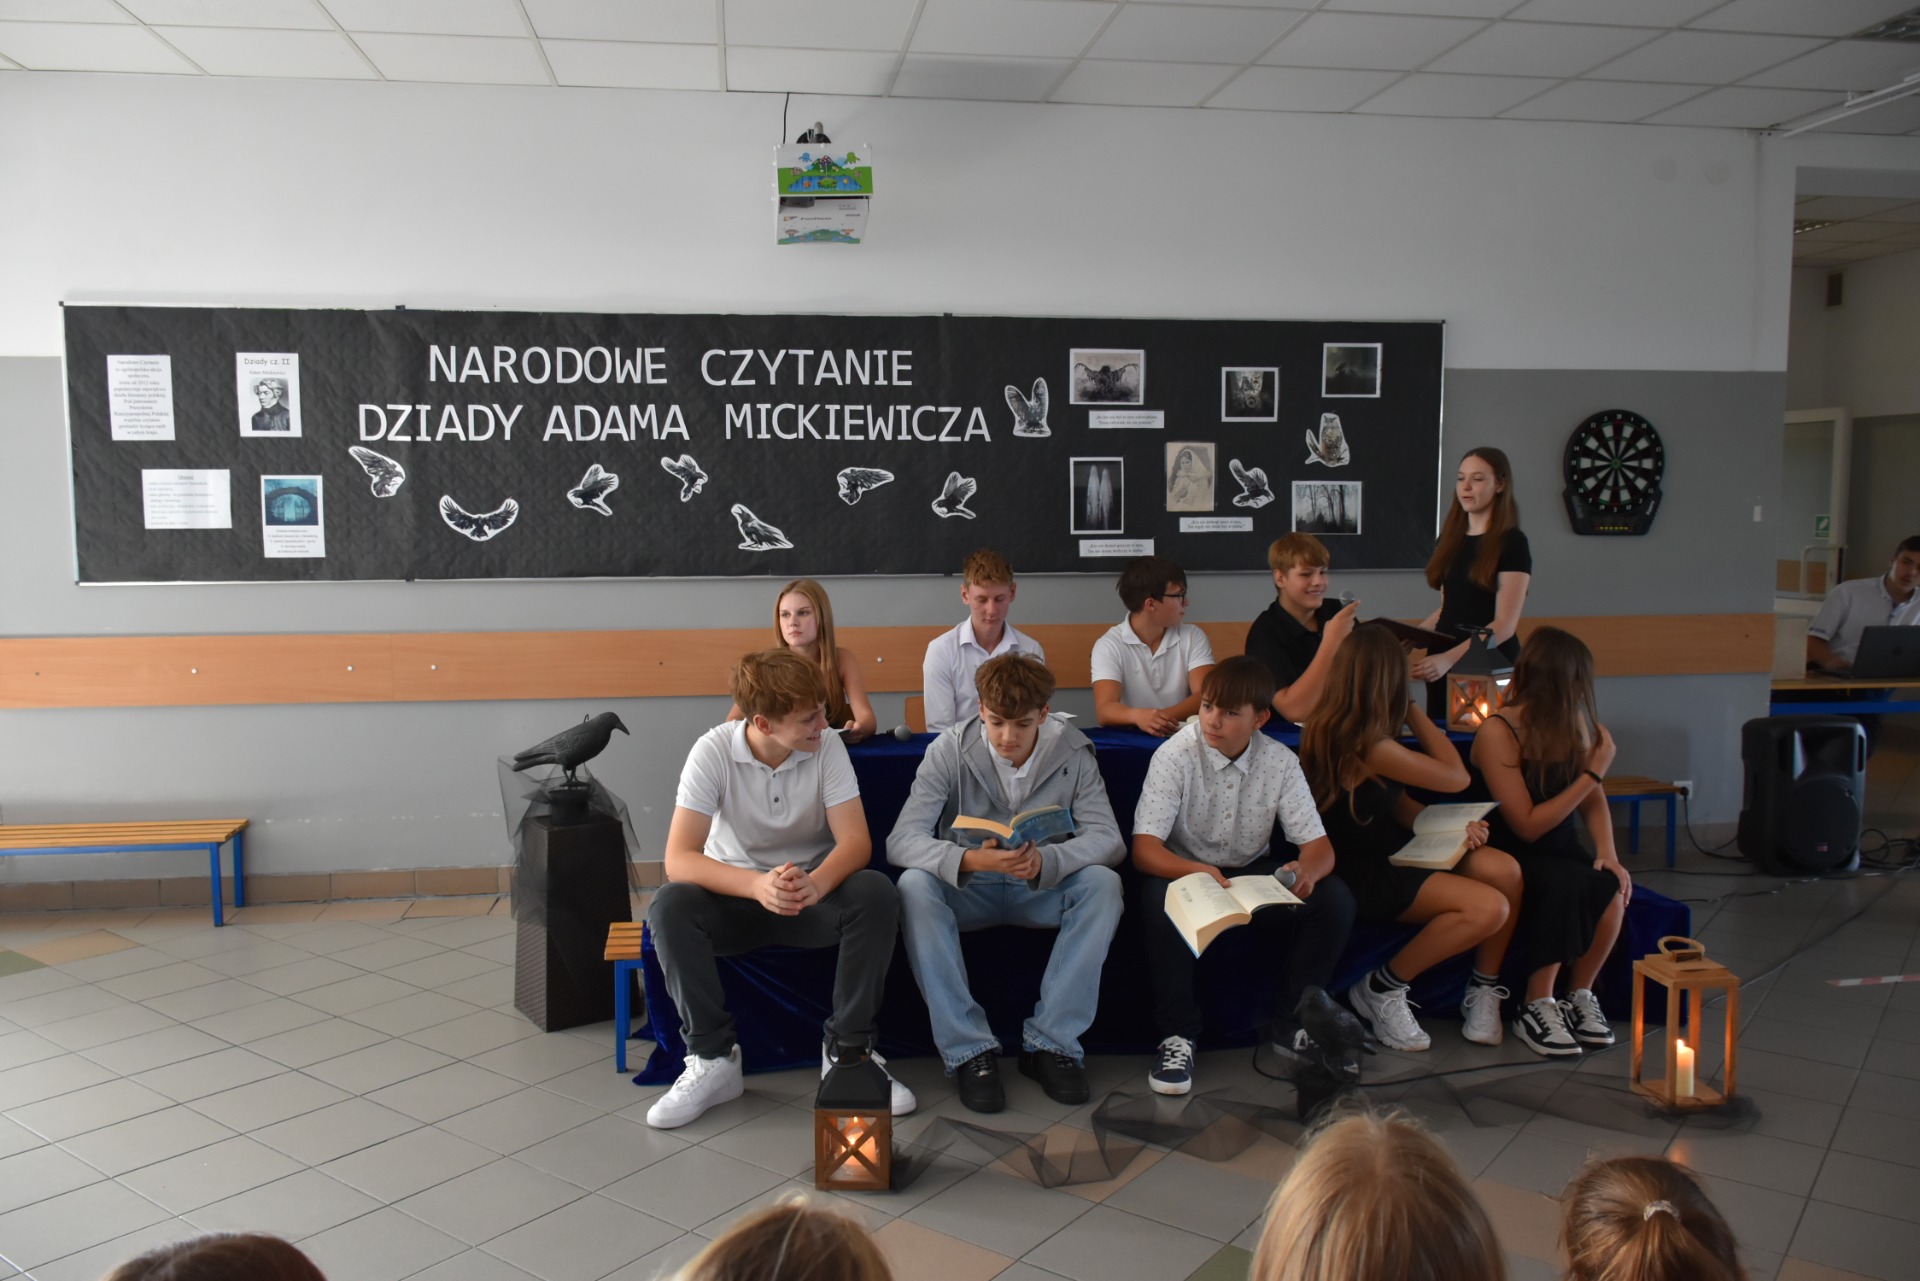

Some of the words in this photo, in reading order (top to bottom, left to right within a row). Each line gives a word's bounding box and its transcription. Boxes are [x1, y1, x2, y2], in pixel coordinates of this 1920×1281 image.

[244, 357, 268, 366] Dziady
[429, 345, 668, 385] NARODOWE
[700, 349, 913, 387] CZYTANIE
[358, 403, 524, 442] DZIADY
[543, 403, 691, 442] ADAMA
[725, 403, 992, 442] MICKIEWICZA
